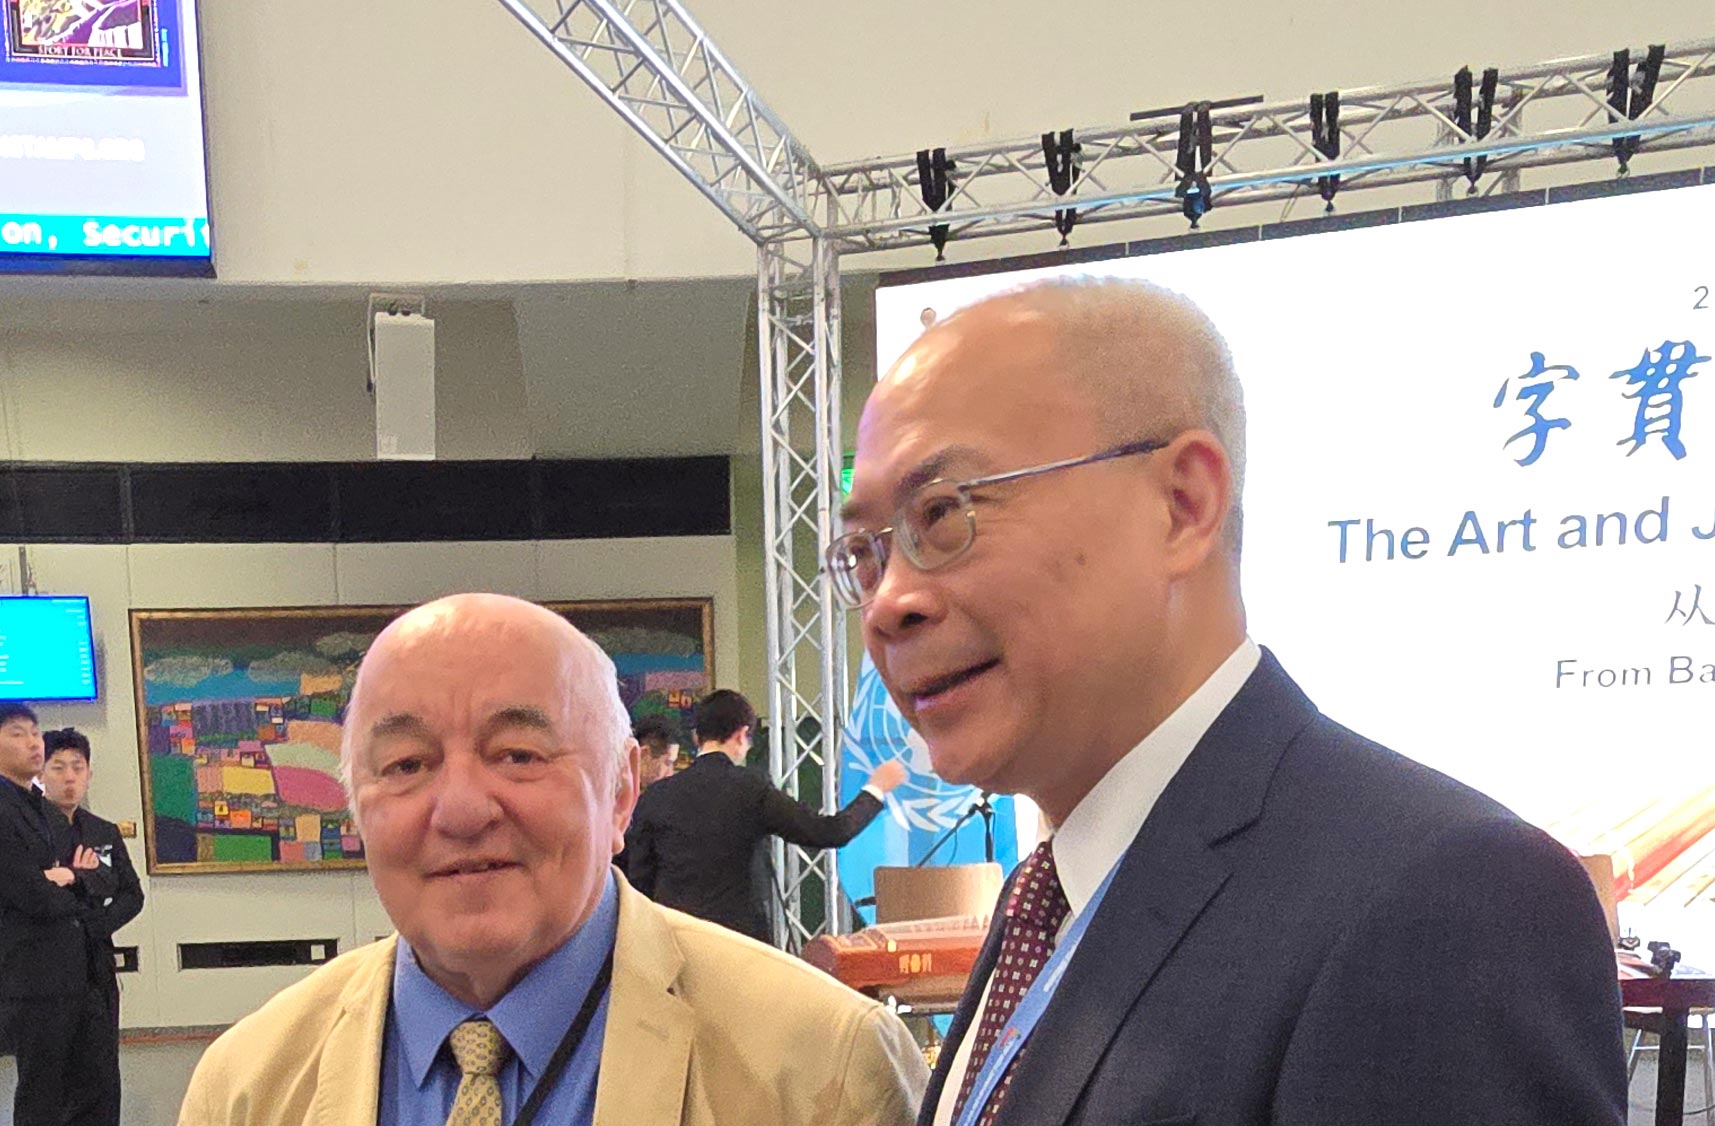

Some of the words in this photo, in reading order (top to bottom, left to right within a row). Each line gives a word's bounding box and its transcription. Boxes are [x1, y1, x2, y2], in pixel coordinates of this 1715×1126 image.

[1328, 518, 1430, 563] The
[1447, 509, 1538, 557] Art
[1557, 496, 1670, 549] and
[1664, 583, 1715, 626] 从
[1556, 659, 1651, 689] From
[1669, 656, 1715, 684] Ba
